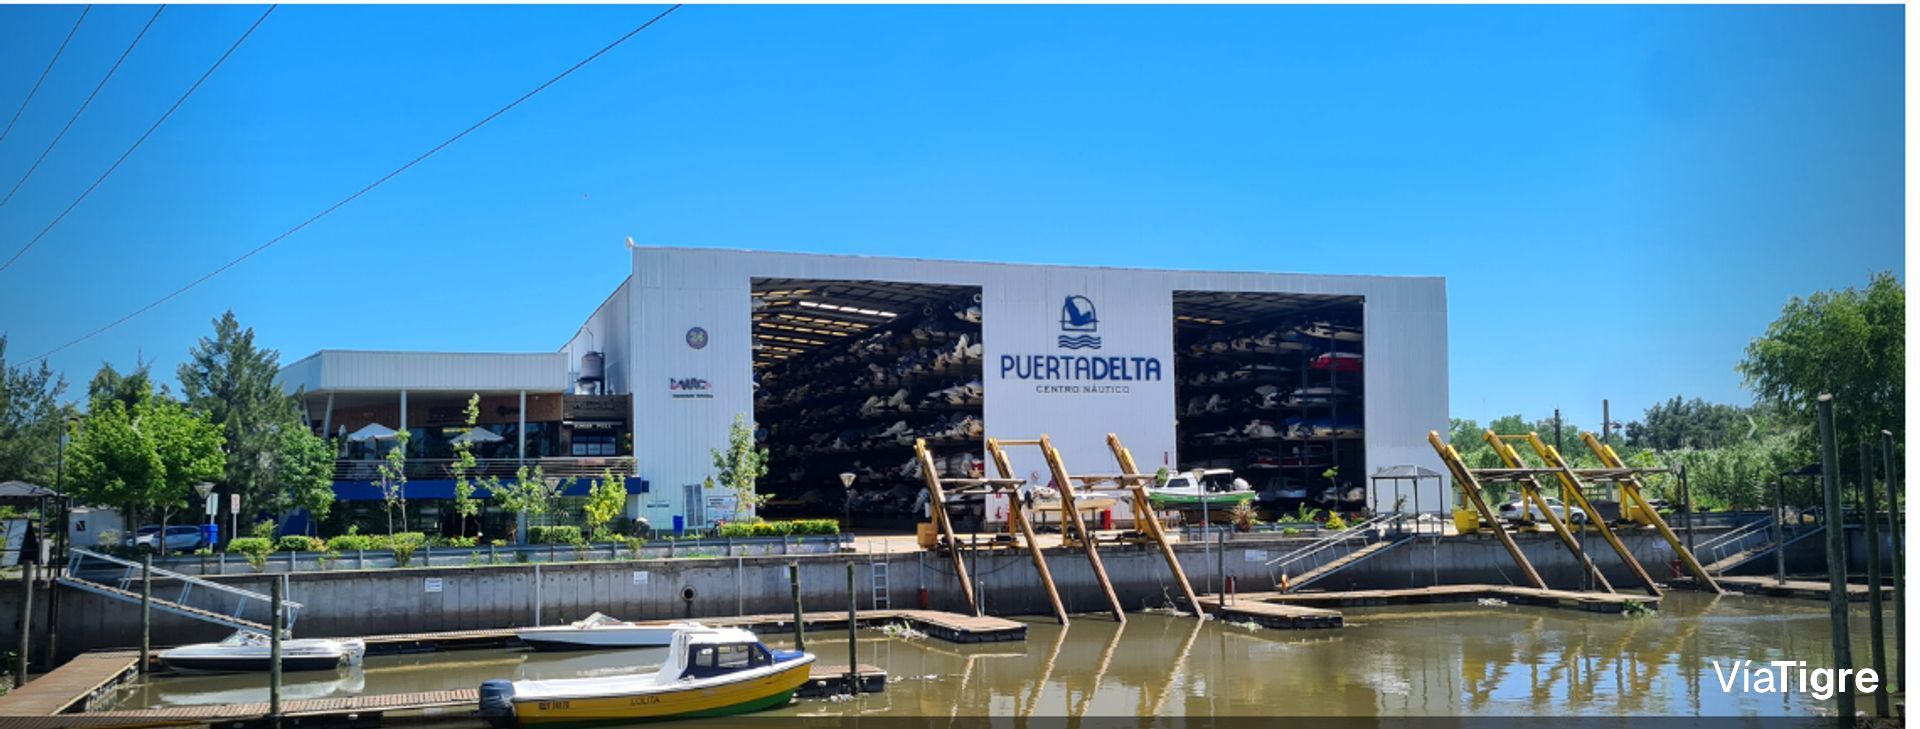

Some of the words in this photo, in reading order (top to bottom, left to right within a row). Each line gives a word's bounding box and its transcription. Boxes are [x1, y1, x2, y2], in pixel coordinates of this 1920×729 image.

[1000, 355, 1161, 381] PUERTADELTA
[1035, 385, 1079, 394] CENTRO
[1083, 384, 1130, 394] NÁUTICO
